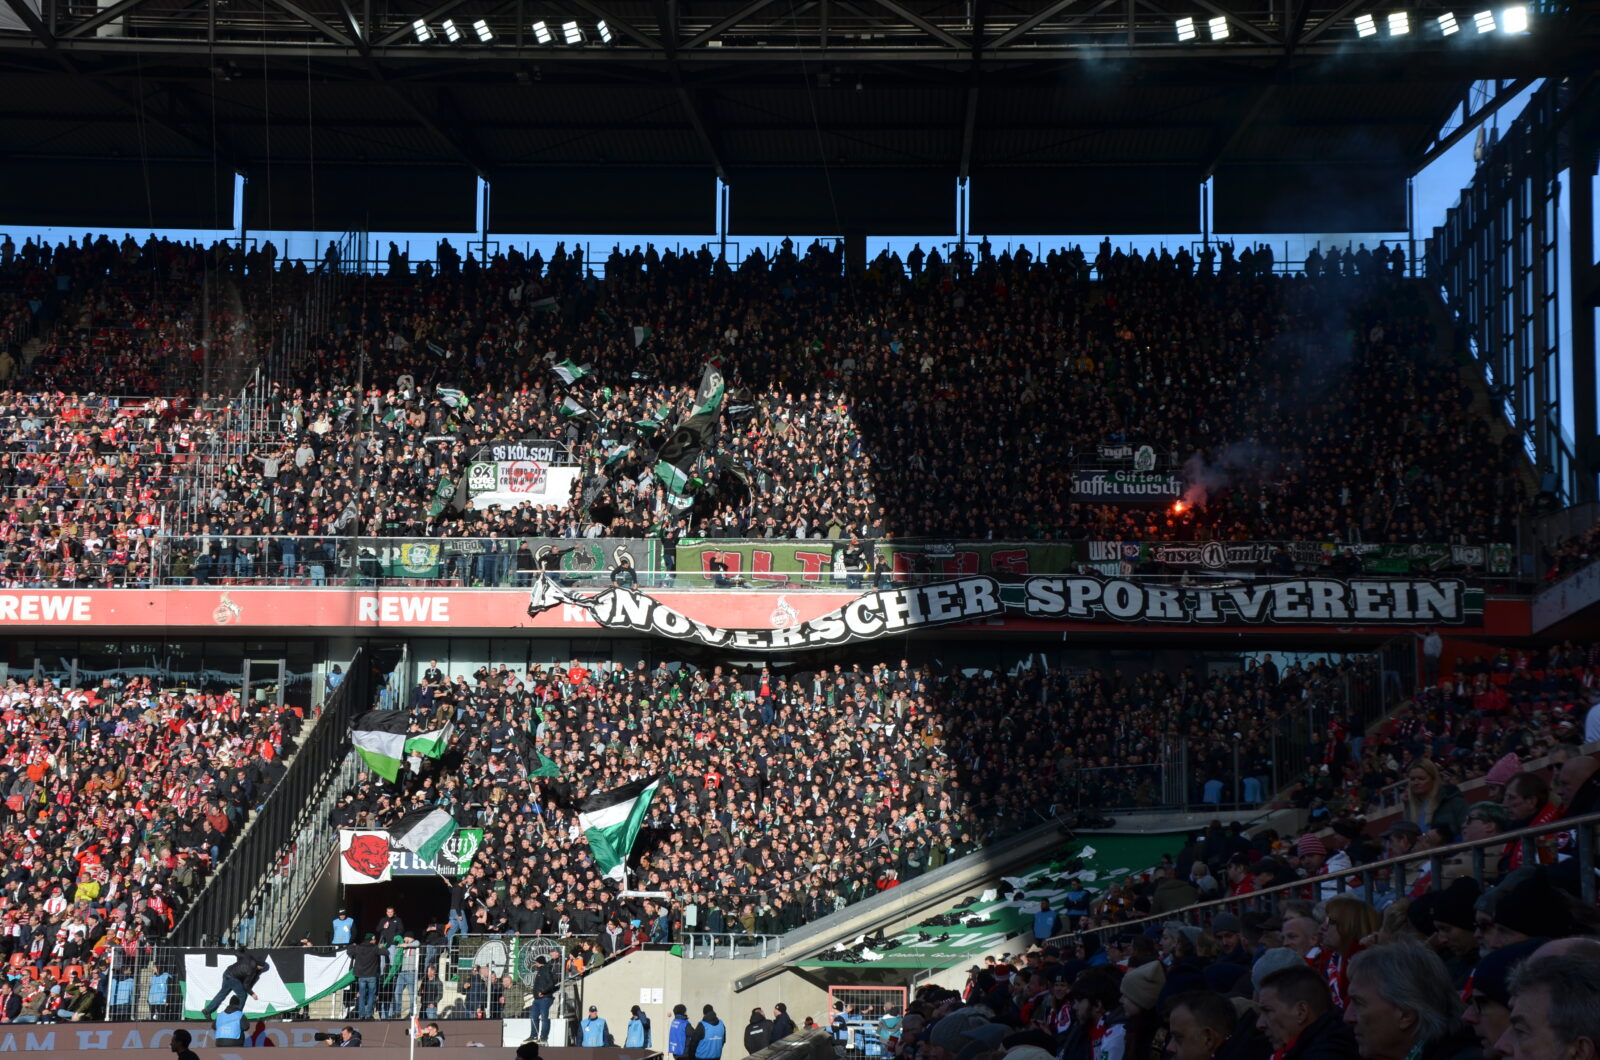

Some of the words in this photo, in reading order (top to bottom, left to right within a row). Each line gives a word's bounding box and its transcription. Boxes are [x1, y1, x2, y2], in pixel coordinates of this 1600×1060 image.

[493, 445, 506, 461] 96
[1088, 541, 1122, 561] WEST
[0, 595, 91, 621] REWE
[358, 596, 449, 622] REWE
[1026, 579, 1460, 622] SPORTVEREIN
